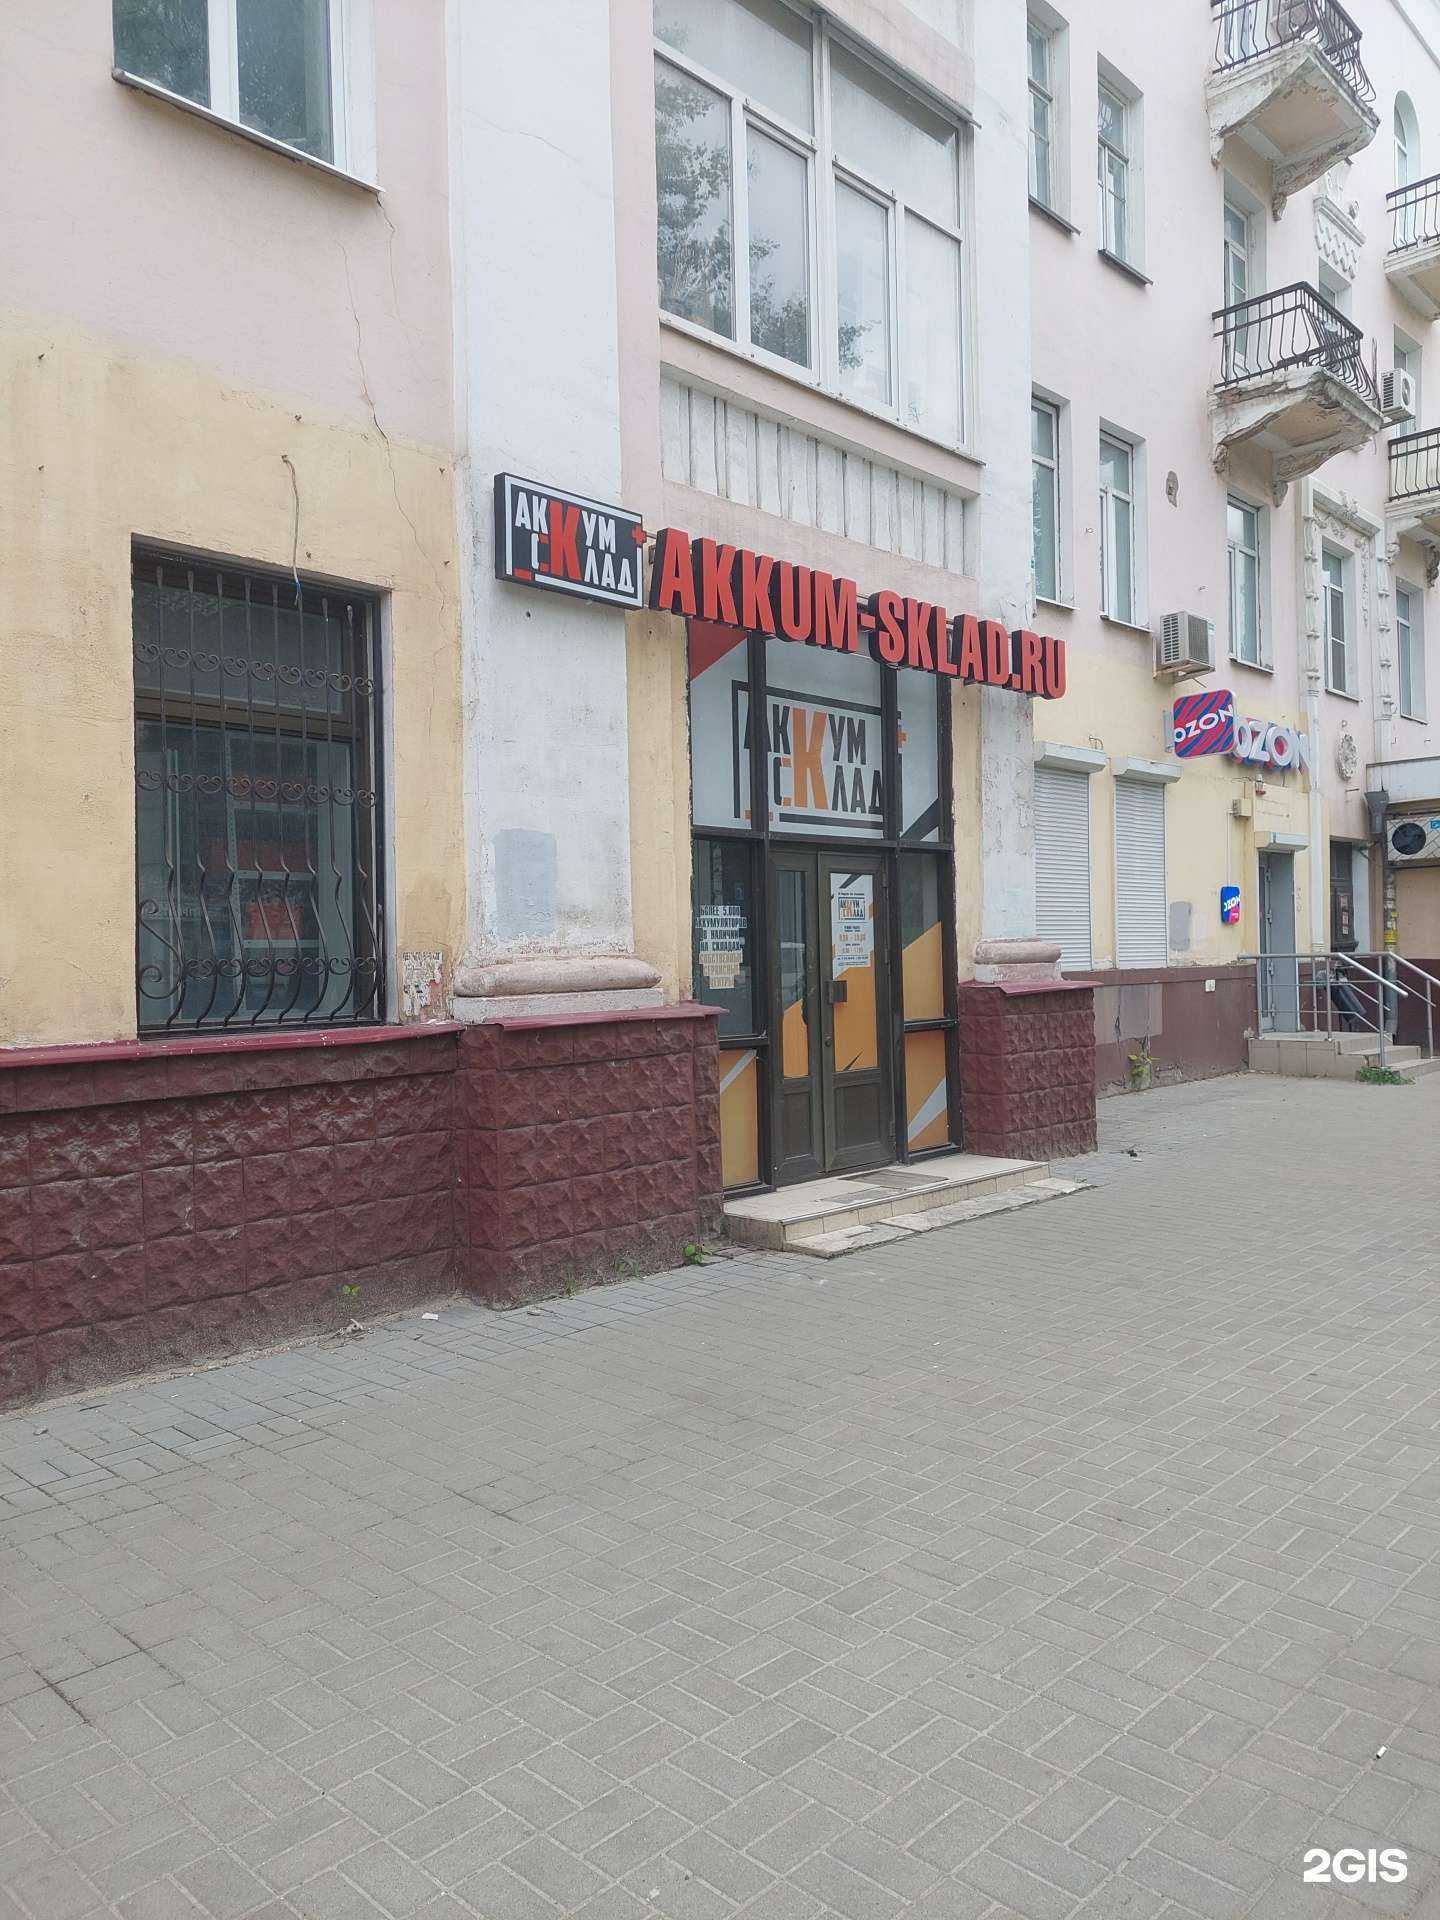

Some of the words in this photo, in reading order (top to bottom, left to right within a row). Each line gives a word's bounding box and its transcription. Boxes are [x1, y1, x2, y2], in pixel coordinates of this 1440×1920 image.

[651, 528, 1067, 700] AKKUM-SKLAD.RU
[1174, 704, 1234, 743] OZON
[1233, 718, 1311, 770] OZON
